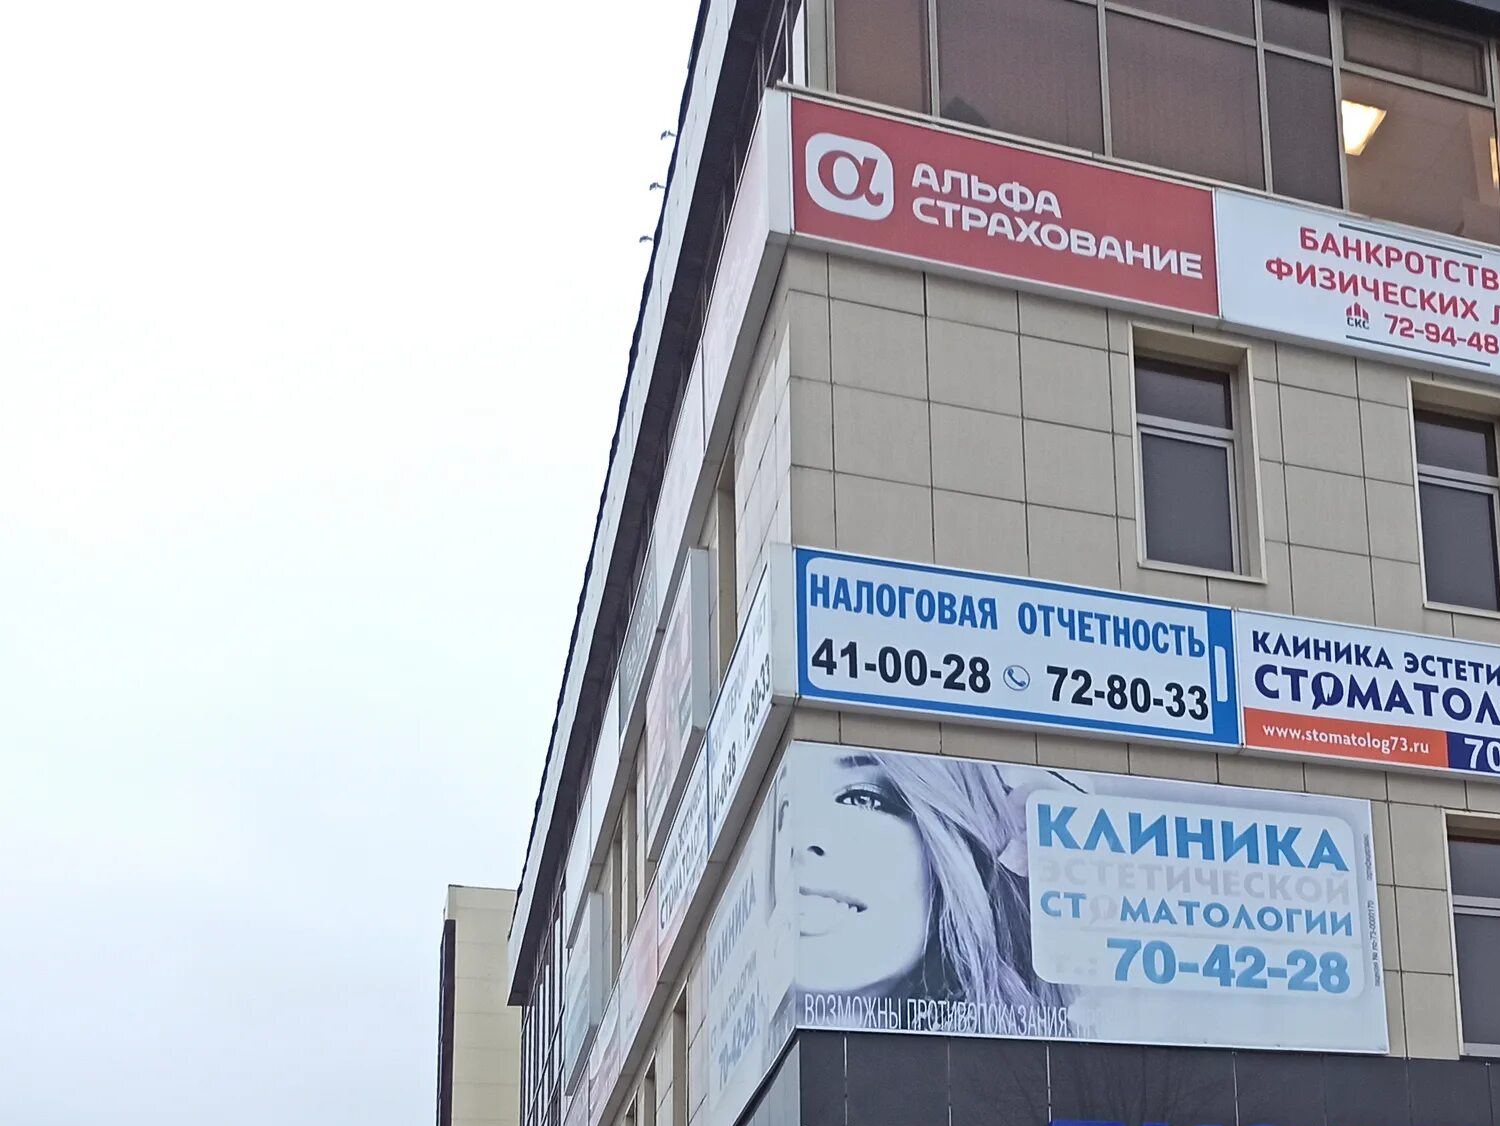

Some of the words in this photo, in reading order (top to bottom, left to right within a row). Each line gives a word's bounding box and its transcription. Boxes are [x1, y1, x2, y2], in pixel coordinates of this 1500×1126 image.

[911, 163, 1063, 219] АЛЬФА
[911, 197, 1205, 280] СТРАХОВАНИЕ
[1265, 257, 1480, 322] ФИЗИЧЕСКИХ
[1384, 313, 1500, 355] 72-94-48
[809, 572, 998, 631] НАЛОГОВАЯ
[1017, 602, 1206, 659] ОТЧЕТНОСТЬ
[810, 637, 992, 694] 41-00-28
[1251, 630, 1393, 671] КЛИНИКА
[1046, 665, 1209, 721] 72-80-33
[1262, 723, 1430, 755] www.stomatolog73.ru
[1036, 802, 1350, 873] КЛИНИКА
[1037, 856, 1349, 905] ЭСТЕТИЧЕСКОЙ
[1106, 937, 1350, 994] 70-42-28
[804, 993, 901, 1029] ВОЗМОЖНЫ
